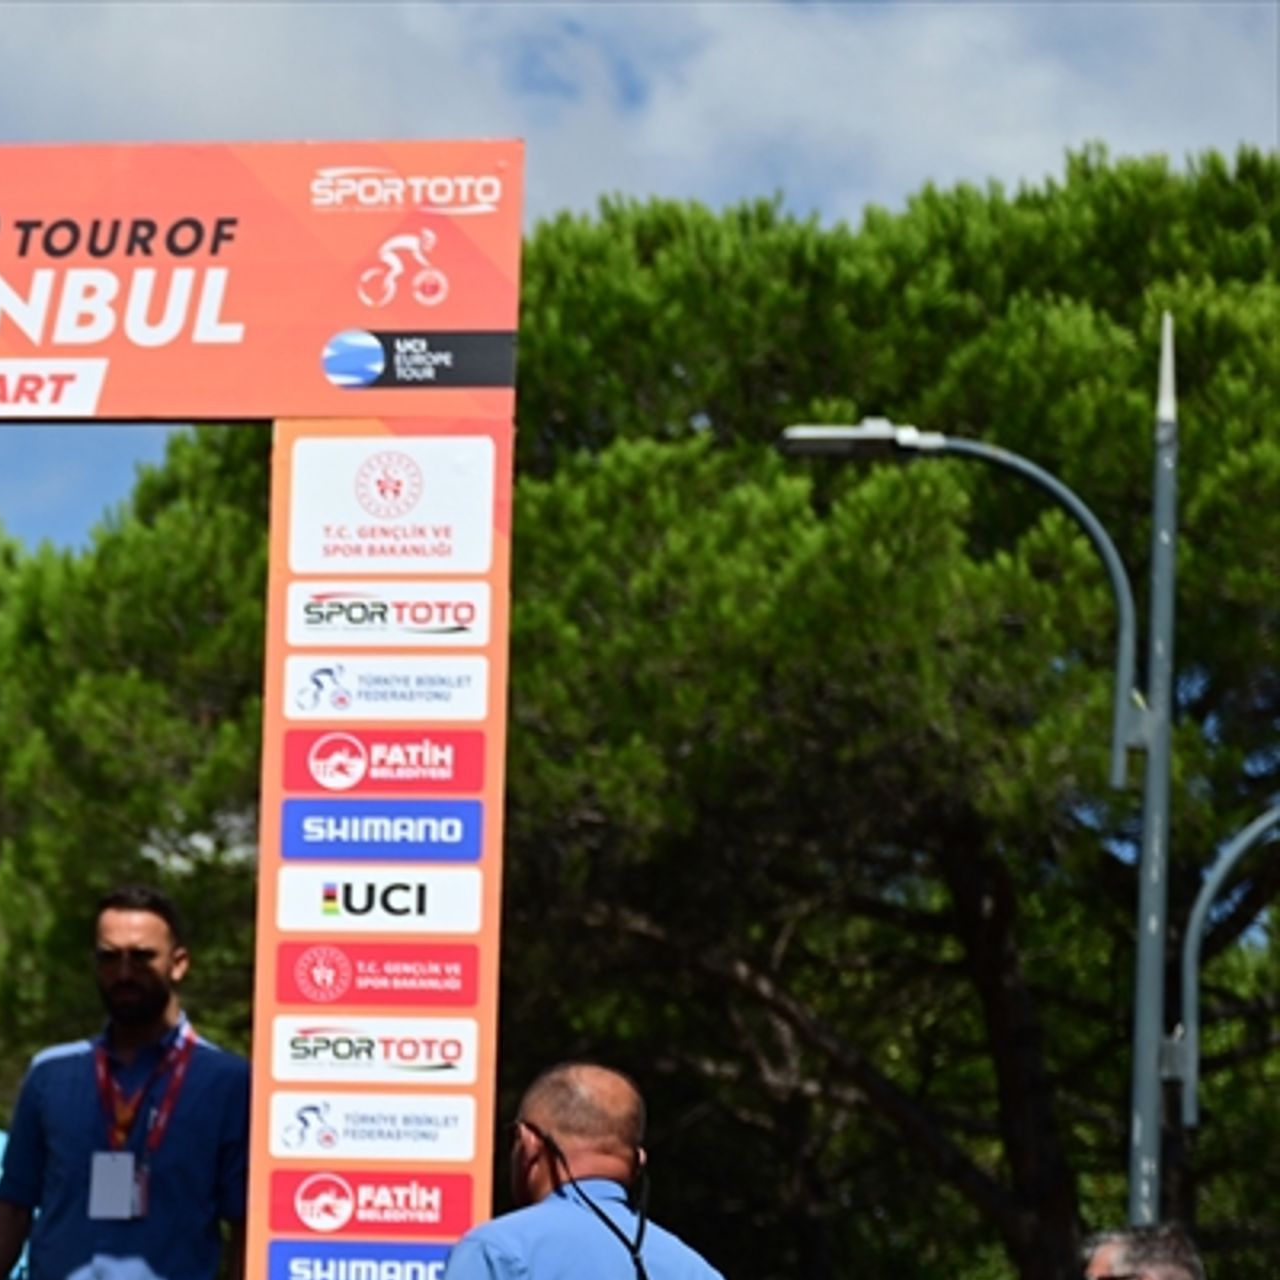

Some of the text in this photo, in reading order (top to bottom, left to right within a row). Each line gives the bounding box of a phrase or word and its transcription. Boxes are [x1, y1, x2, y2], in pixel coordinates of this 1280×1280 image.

[395, 338, 427, 351] UCI
[394, 352, 453, 366] EUROPE
[395, 366, 436, 380] TOUR
[432, 525, 453, 538] VE
[323, 544, 362, 557] SPOR
[370, 739, 454, 767] FATİH
[303, 816, 462, 843] SHIMANO
[342, 883, 427, 916] UCI
[357, 1180, 441, 1210] FATİH
